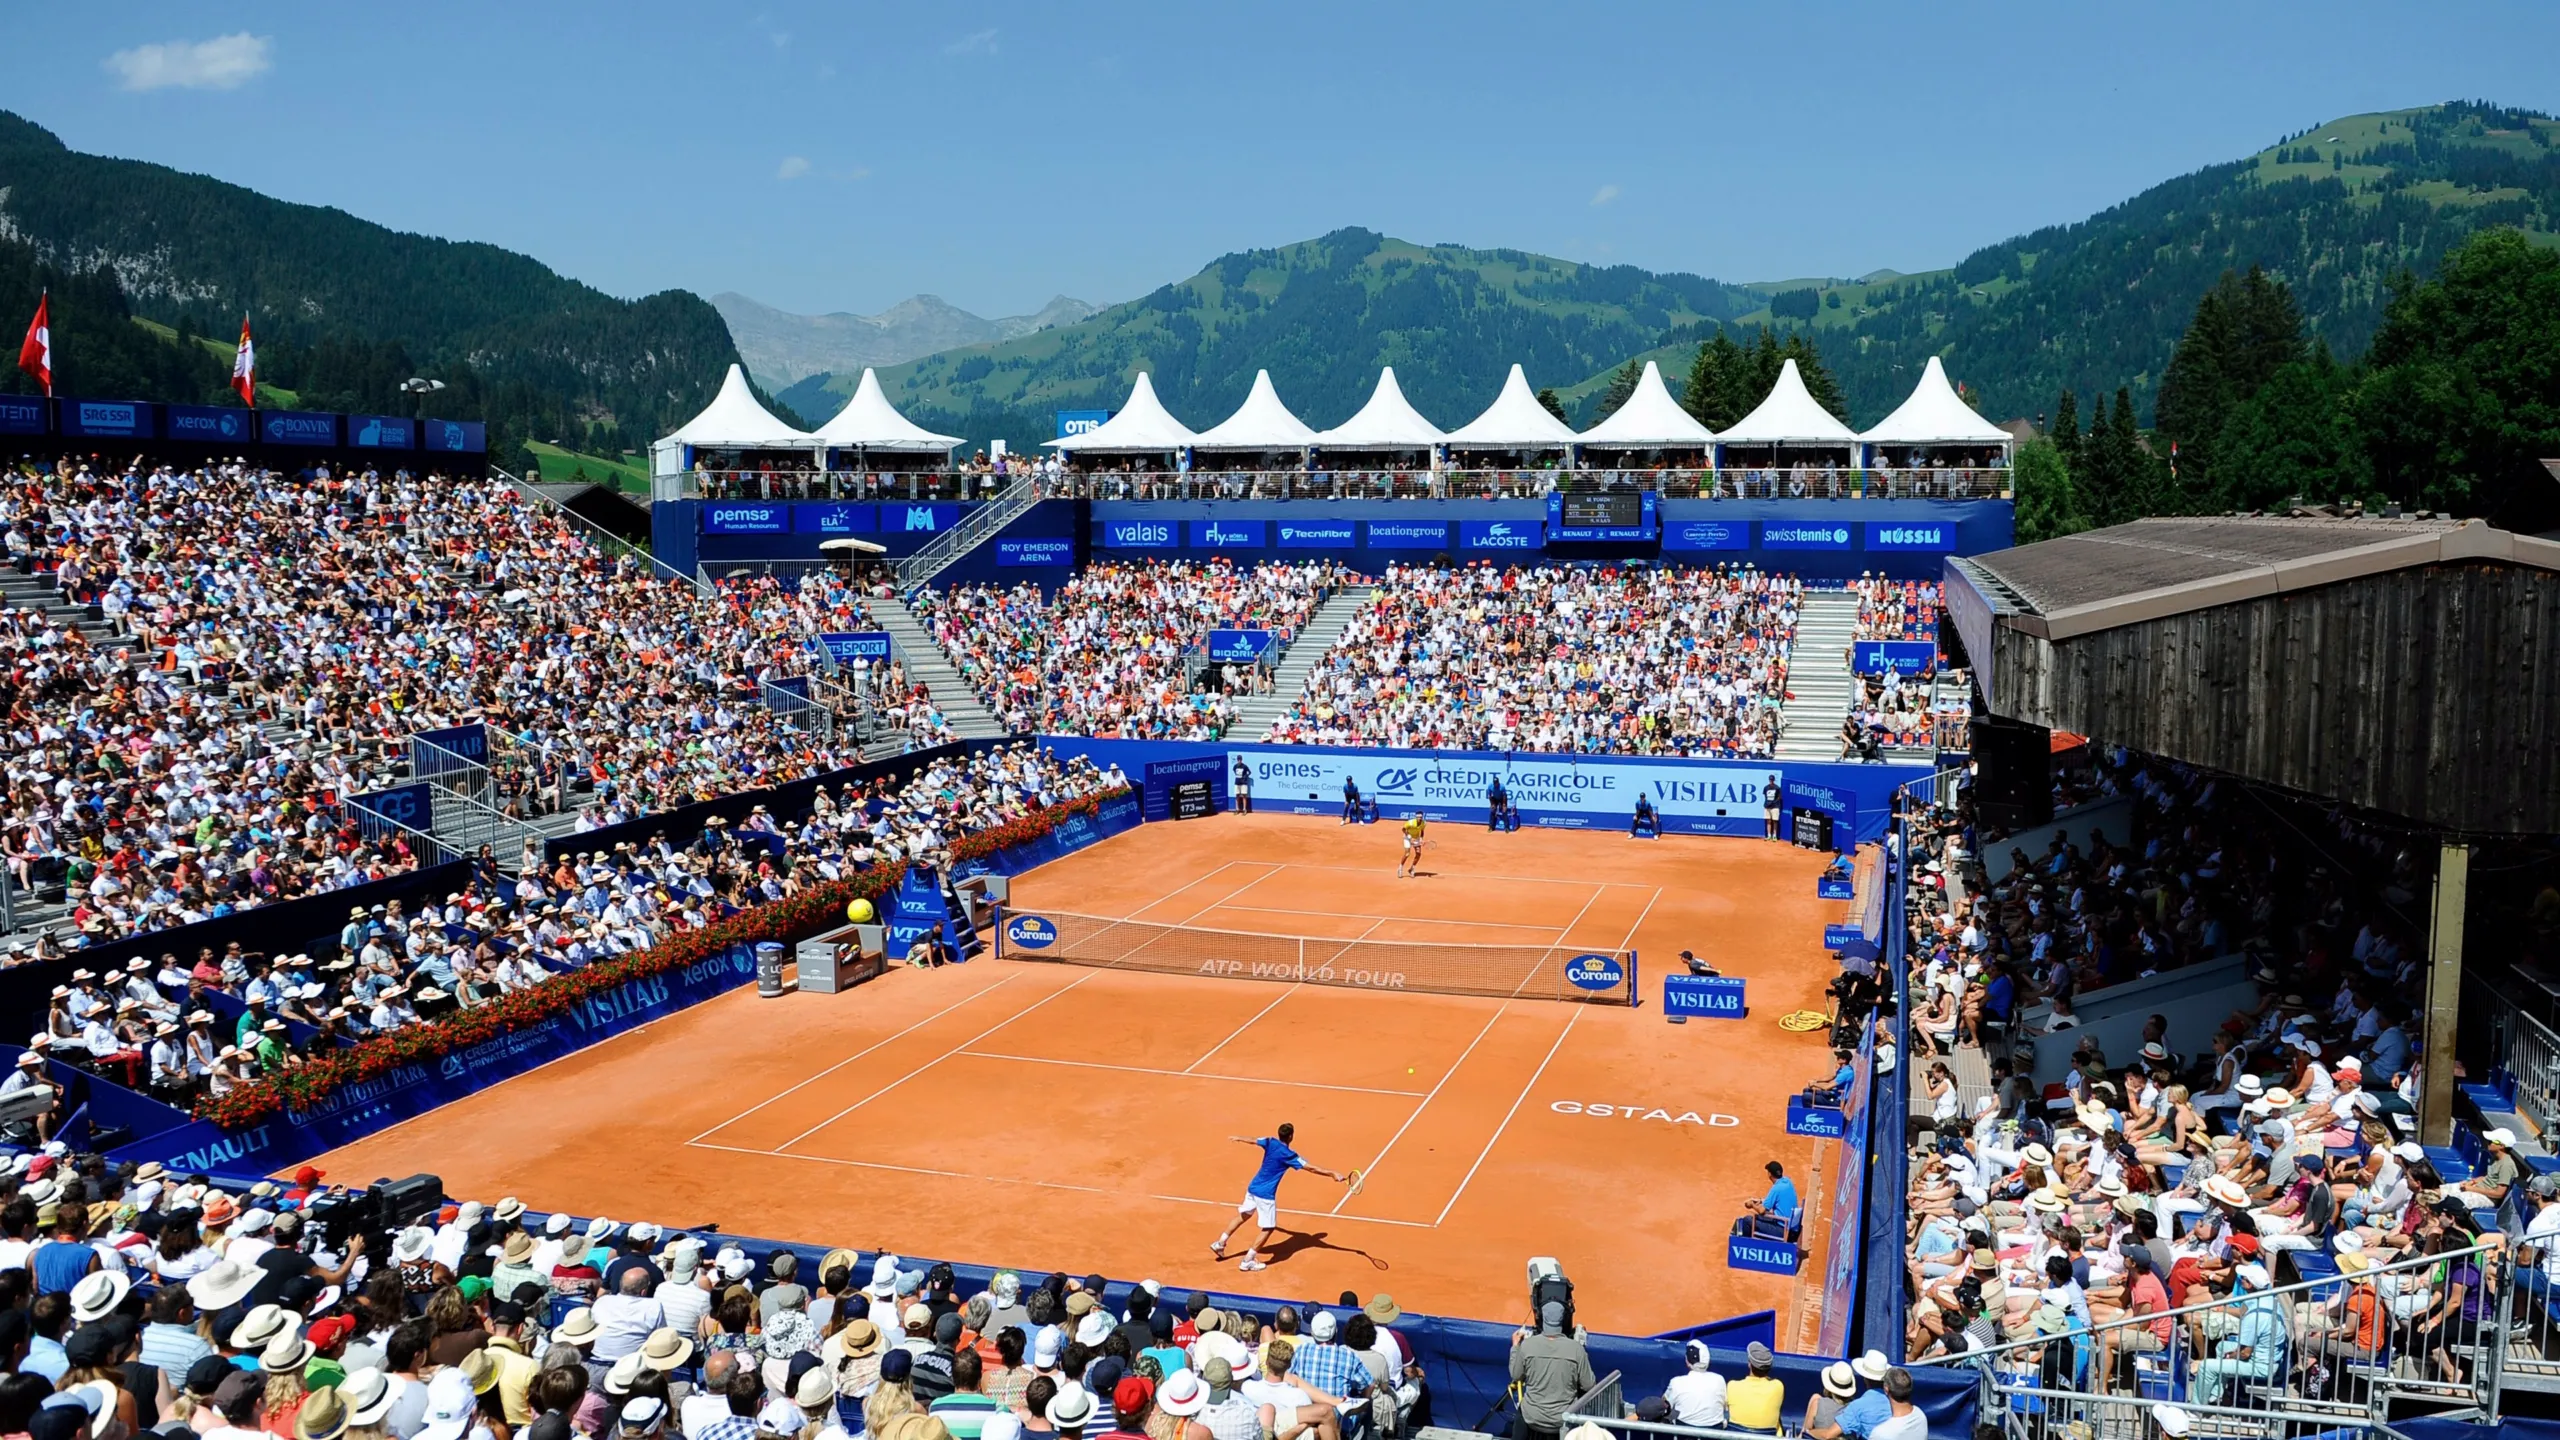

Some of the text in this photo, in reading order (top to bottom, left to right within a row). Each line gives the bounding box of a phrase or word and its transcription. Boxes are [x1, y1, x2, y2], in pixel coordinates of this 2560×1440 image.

[83, 408, 132, 423] SRG SSR
[176, 415, 217, 430] xerox
[286, 418, 330, 433] BONVIN
[1065, 420, 1100, 434] OTIS
[714, 509, 770, 525] pemsa
[1115, 522, 1168, 541] valais
[1294, 530, 1351, 538] Tecnifibre
[1370, 524, 1446, 539] locationgroup
[1764, 529, 1832, 542] swisstennis
[1001, 543, 1069, 552] ROY EMERSON
[1472, 536, 1528, 547] LACOSTE
[1019, 553, 1053, 562] ARENA
[843, 641, 885, 654] SPORT
[1153, 759, 1221, 775] locationgroup
[1278, 781, 1291, 789] The
[1292, 782, 1320, 790] Genetic
[1424, 767, 1502, 785] CRÉDIT
[1506, 772, 1616, 790] AGRICOLE
[1179, 783, 1205, 793] pemsa
[1653, 780, 1758, 804] VISILAB
[1789, 783, 1834, 801] nationale
[1506, 790, 1581, 804] BANKING
[1180, 804, 1195, 812] 173
[1815, 798, 1846, 813] suisse
[1691, 823, 1716, 831] VISILAB
[1797, 831, 1818, 842] 00:55
[901, 901, 927, 911] VTX
[1008, 927, 1054, 942] Corona
[681, 953, 730, 987] xerox
[1199, 958, 1407, 989] ATP WORLD TOUR
[1566, 966, 1621, 985] Corona
[570, 973, 670, 1032] VISILAB
[1668, 990, 1738, 1010] VISILAB
[507, 1017, 560, 1047] AGRICOLE
[468, 1033, 549, 1071] PRIVATE BANKING
[1549, 1099, 1741, 1128] GSTAAD
[1790, 1121, 1839, 1135] LACOSTE
[167, 1124, 271, 1171] ENAULT
[1732, 1245, 1793, 1266] VISILAB
